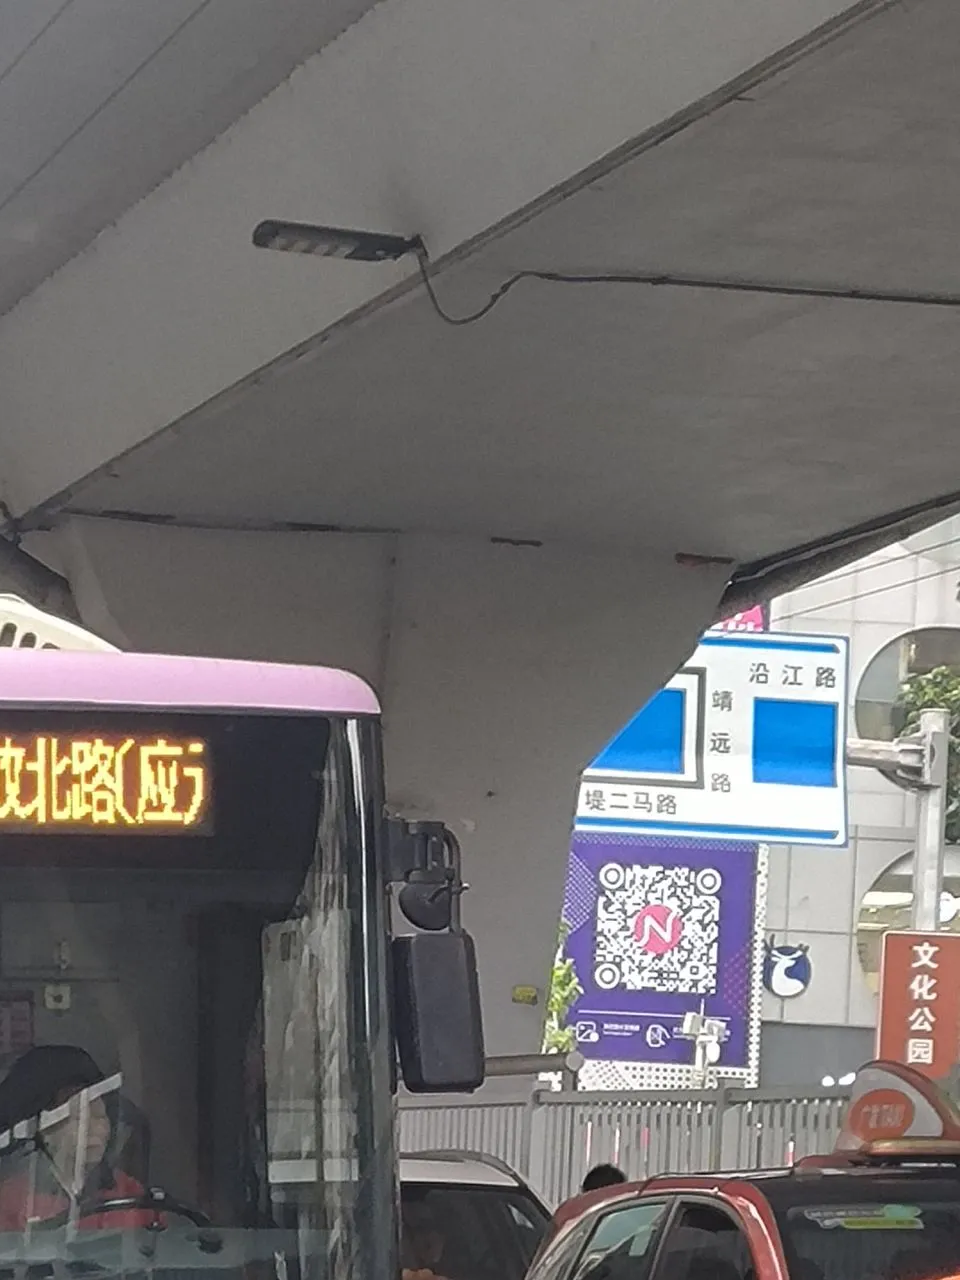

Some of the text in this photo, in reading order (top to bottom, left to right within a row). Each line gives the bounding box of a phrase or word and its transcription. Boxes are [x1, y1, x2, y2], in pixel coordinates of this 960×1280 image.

[749, 662, 837, 689] 沿江路
[710, 690, 734, 793] 靖远路
[585, 789, 678, 815] 堤二马路
[908, 942, 939, 1065] 文化公园
